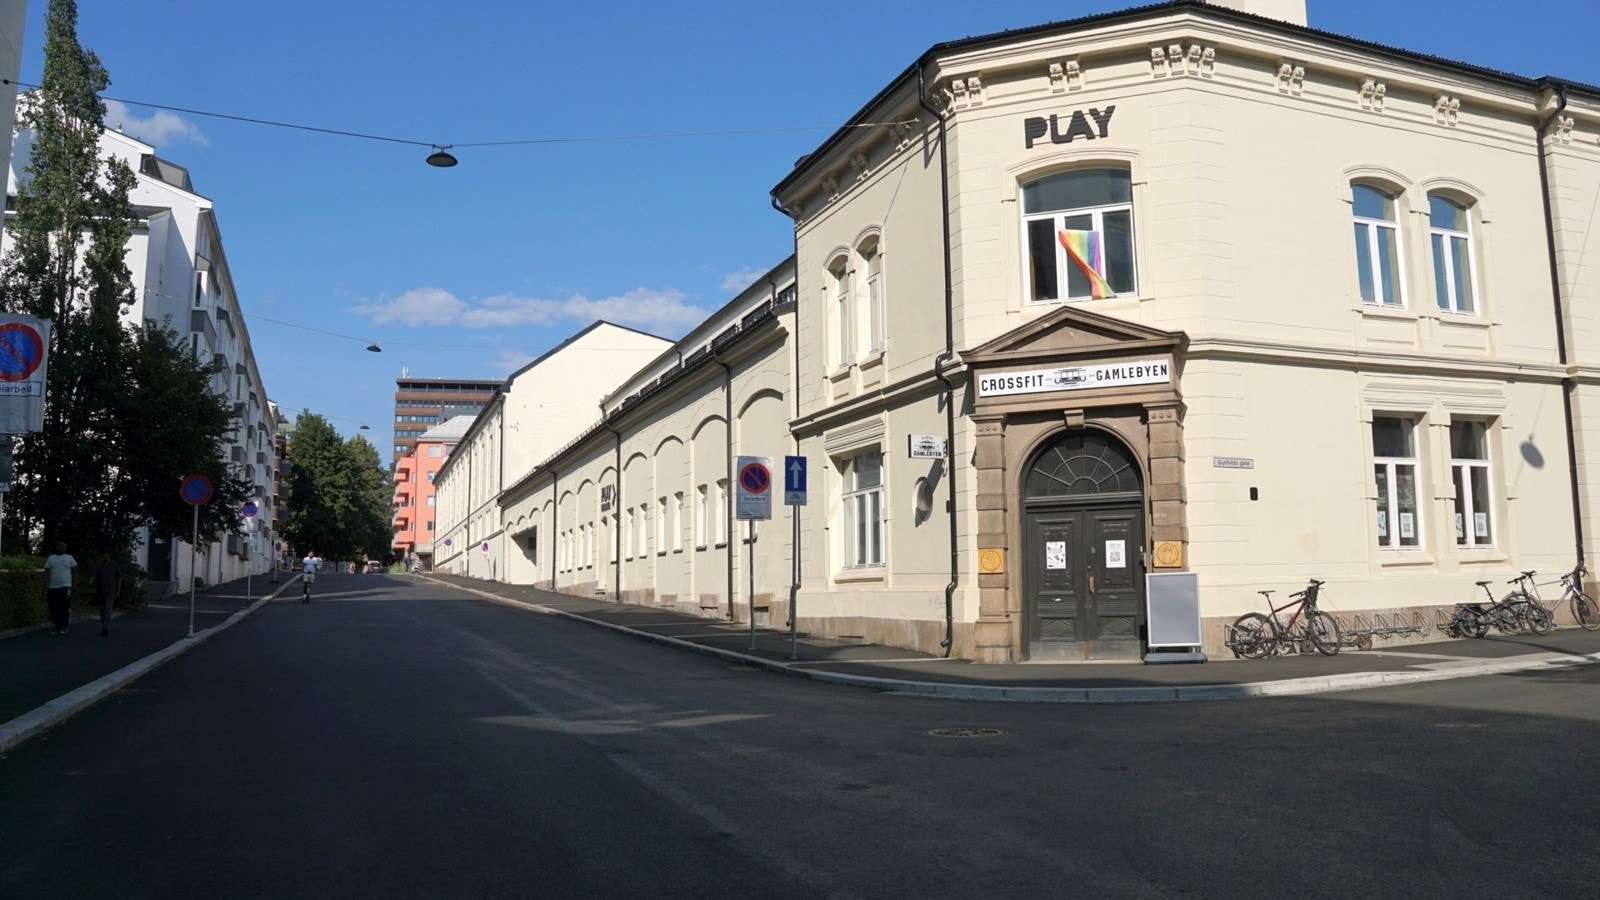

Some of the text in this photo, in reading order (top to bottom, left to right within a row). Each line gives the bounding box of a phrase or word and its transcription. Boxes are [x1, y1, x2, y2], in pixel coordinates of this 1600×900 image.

[1024, 105, 1116, 149] PLAY
[981, 364, 1168, 392] CROSSFIT GAMLEBYEN
